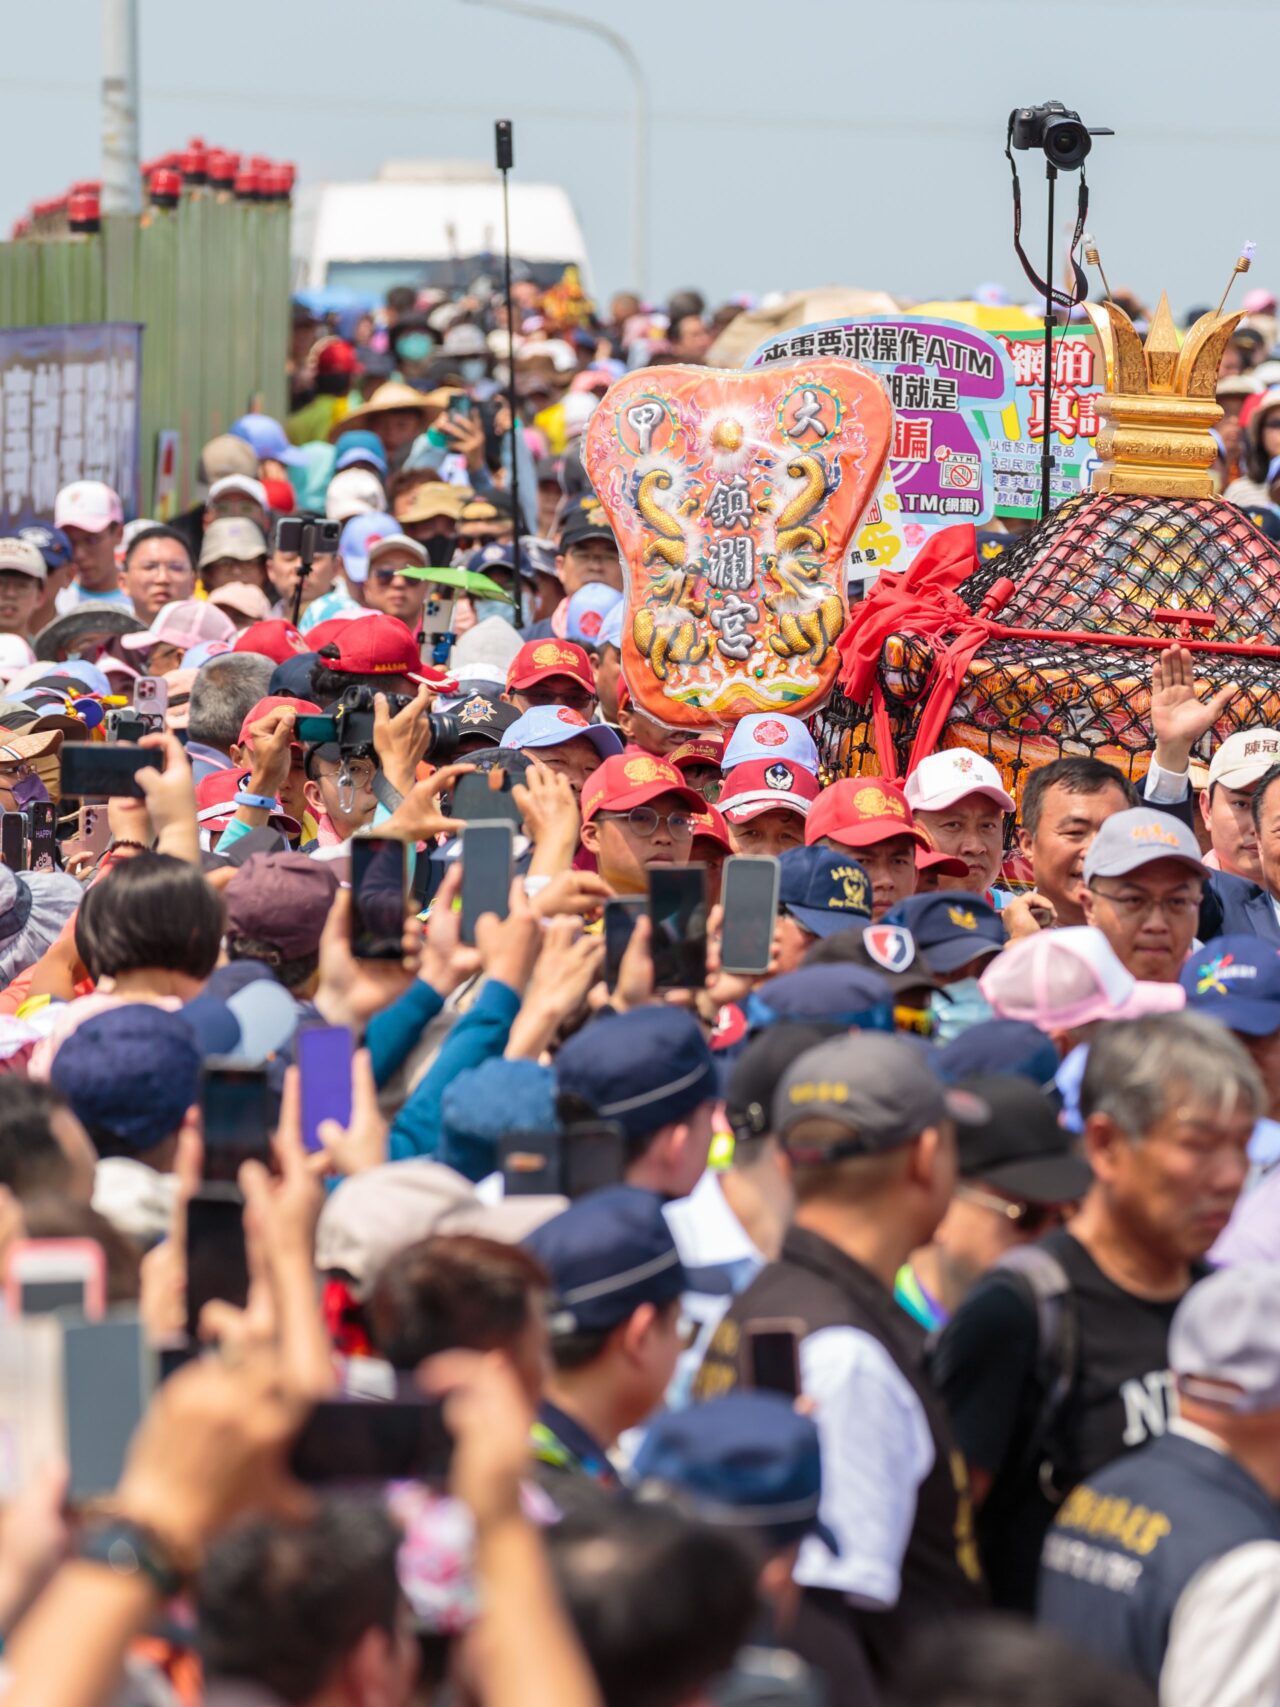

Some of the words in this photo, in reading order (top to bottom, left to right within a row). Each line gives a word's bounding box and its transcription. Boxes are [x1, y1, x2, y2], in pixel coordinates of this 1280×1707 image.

[627, 402, 664, 454] 甲
[788, 390, 828, 437] 大
[990, 441, 1075, 457] 以低於市商品
